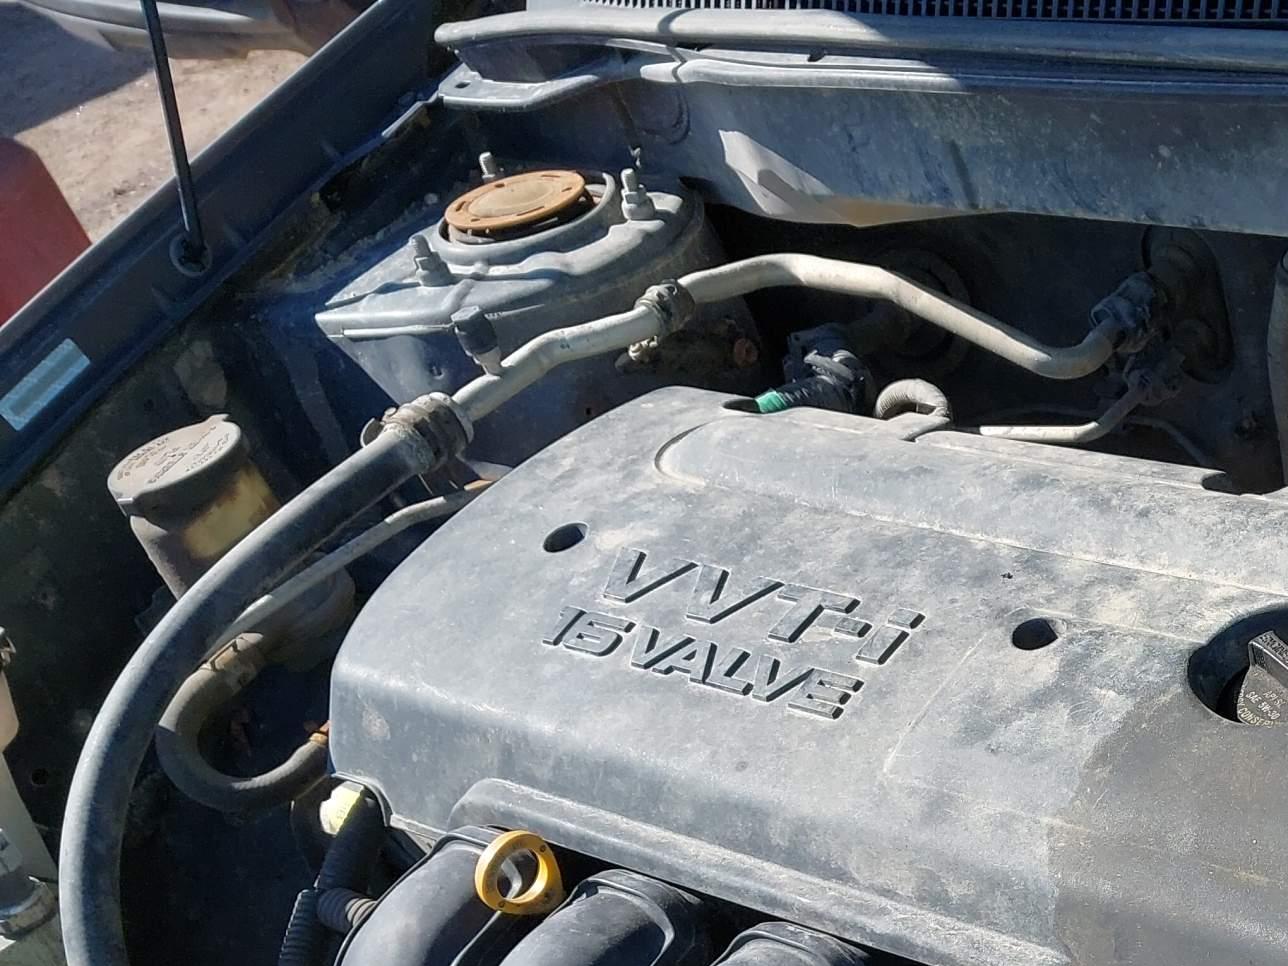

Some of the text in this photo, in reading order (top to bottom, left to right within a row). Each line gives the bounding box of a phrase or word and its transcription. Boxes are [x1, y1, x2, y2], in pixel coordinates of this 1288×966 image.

[542, 606, 864, 720] 16 VALVE
[1246, 691, 1262, 705] SAE
[1258, 699, 1281, 720] 5W-30
